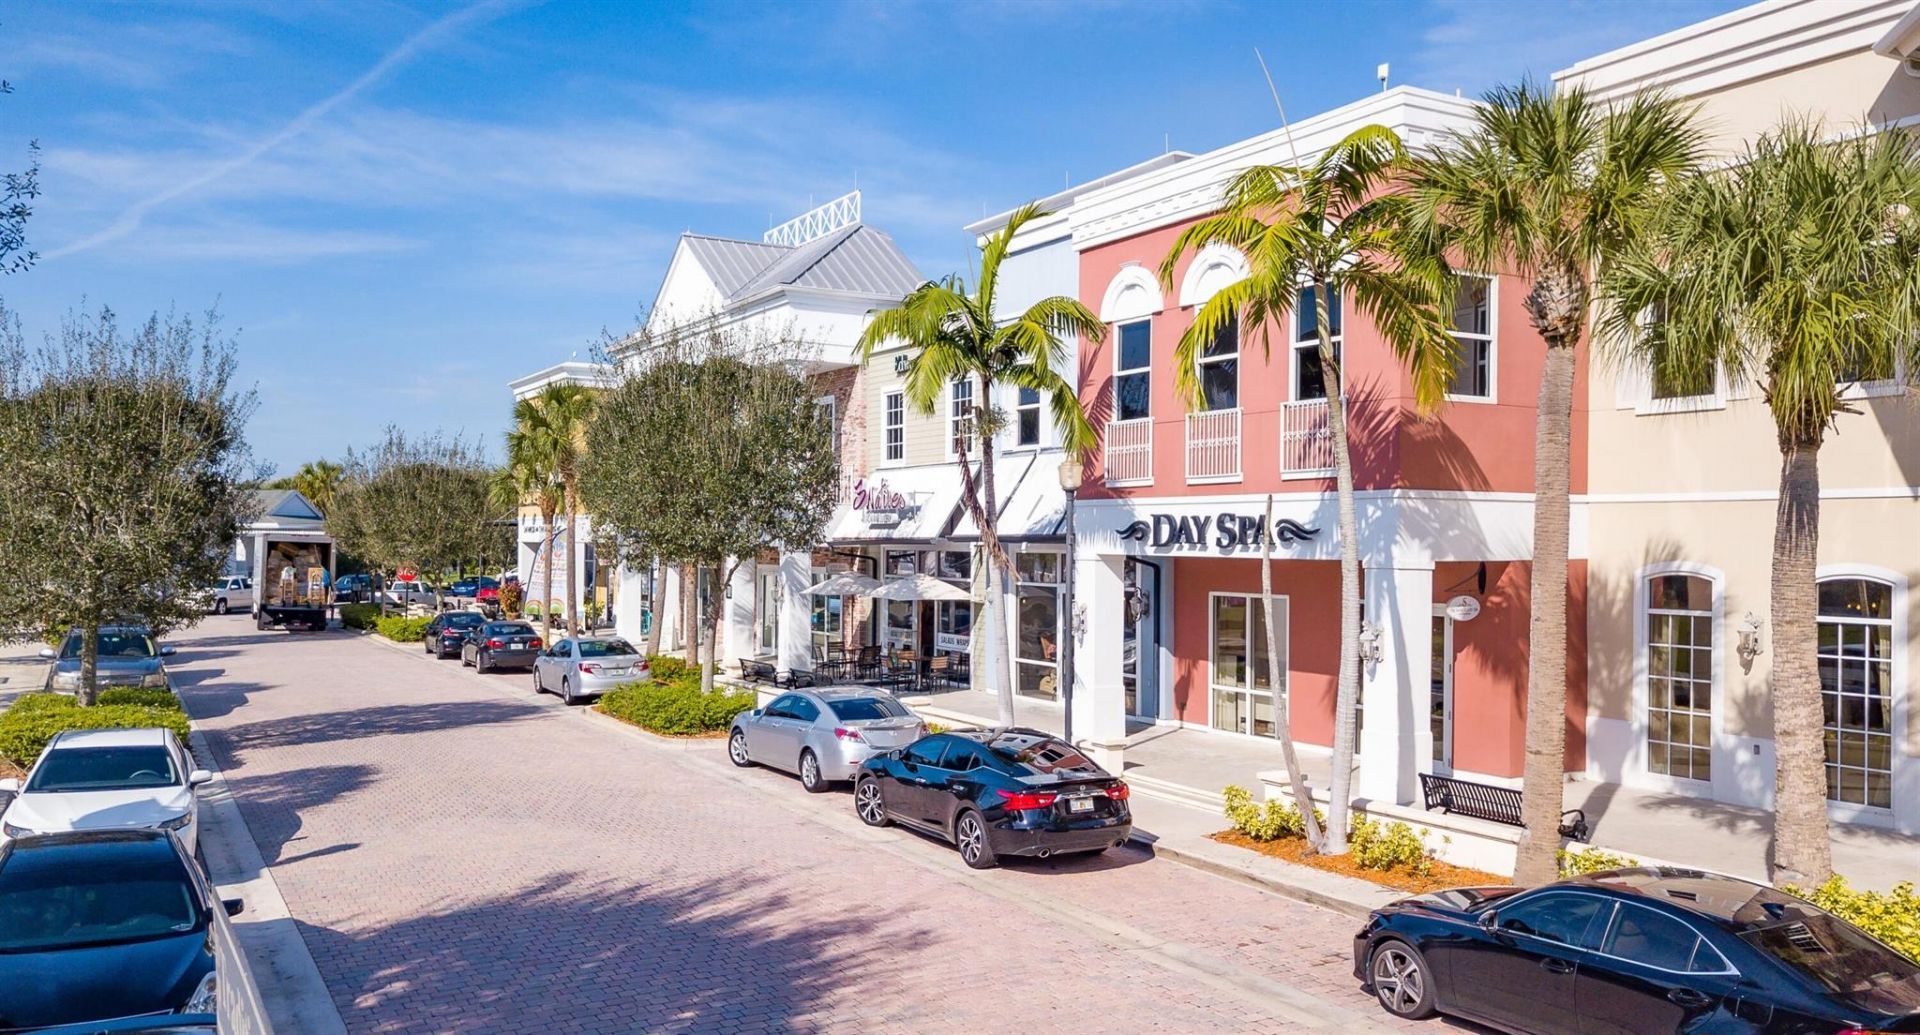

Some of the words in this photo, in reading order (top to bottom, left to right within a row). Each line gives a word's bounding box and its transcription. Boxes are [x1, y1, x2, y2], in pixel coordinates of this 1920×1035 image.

[853, 479, 867, 510] 3
[866, 485, 906, 510] Natives
[1150, 514, 1212, 547] DAY
[1216, 513, 1276, 549] SPA
